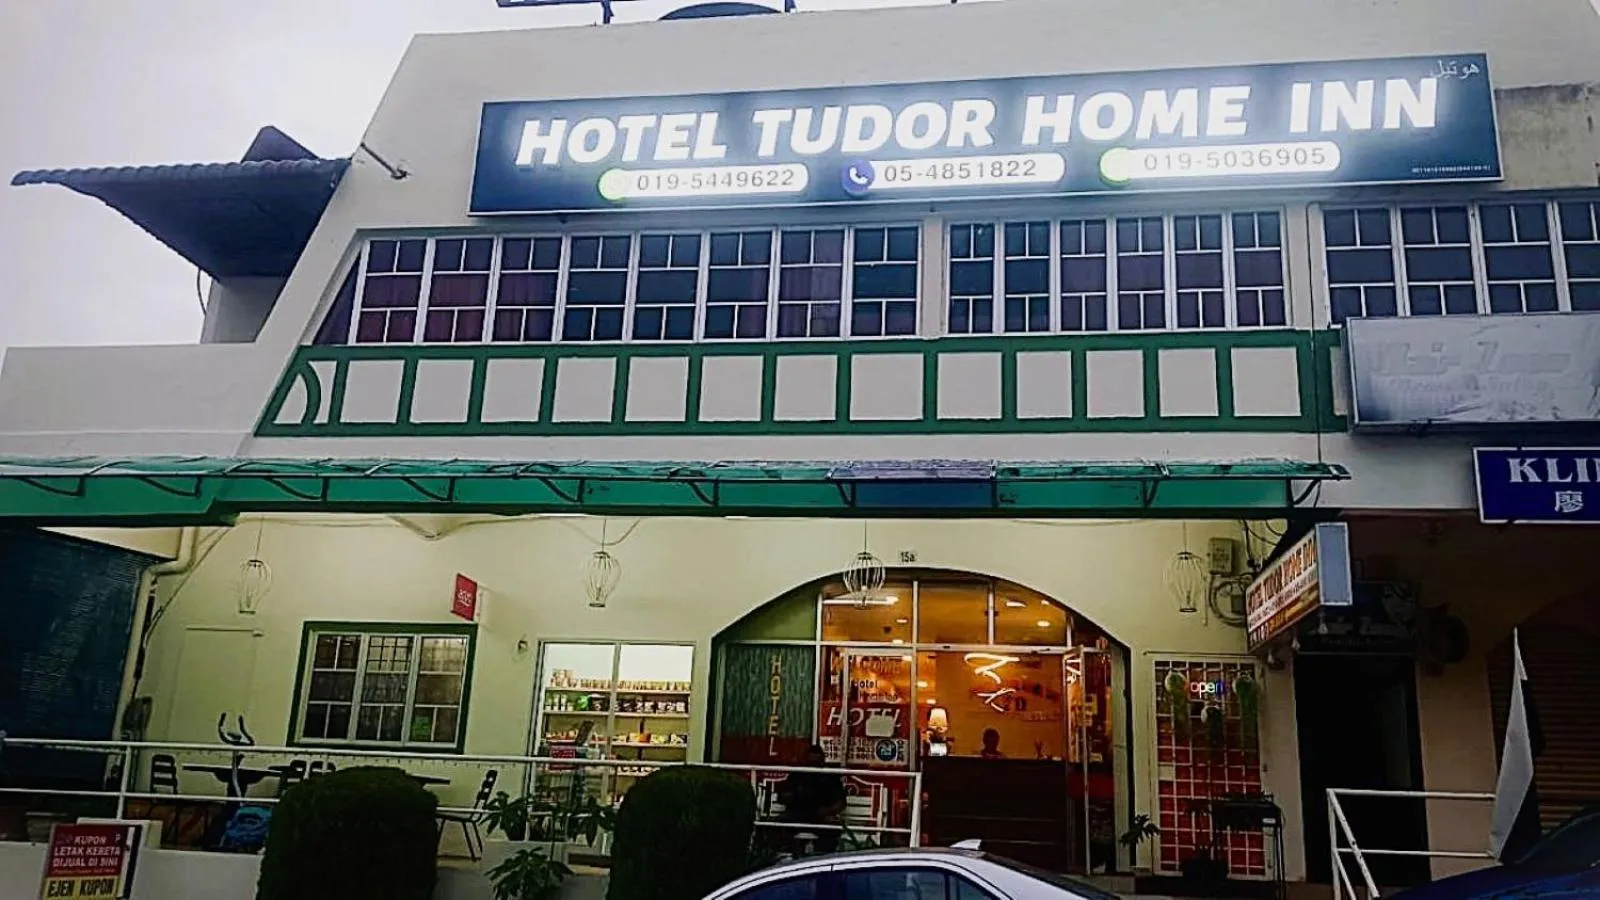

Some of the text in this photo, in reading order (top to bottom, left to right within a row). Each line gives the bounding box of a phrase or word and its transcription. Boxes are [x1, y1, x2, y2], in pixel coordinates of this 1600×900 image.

[516, 77, 1439, 167] HOTEL TUDOR HOME INN
[1144, 147, 1327, 170] 019-5036905
[636, 168, 796, 191] 019-5449622
[883, 158, 1037, 182] 05-4851822
[1190, 681, 1223, 699] open
[768, 654, 782, 756] HOTEL
[74, 835, 107, 845] KUPON
[54, 846, 83, 856] LETAK
[52, 857, 119, 867] DIJUAL DI SINI
[48, 878, 115, 897] EJEN KUPON
